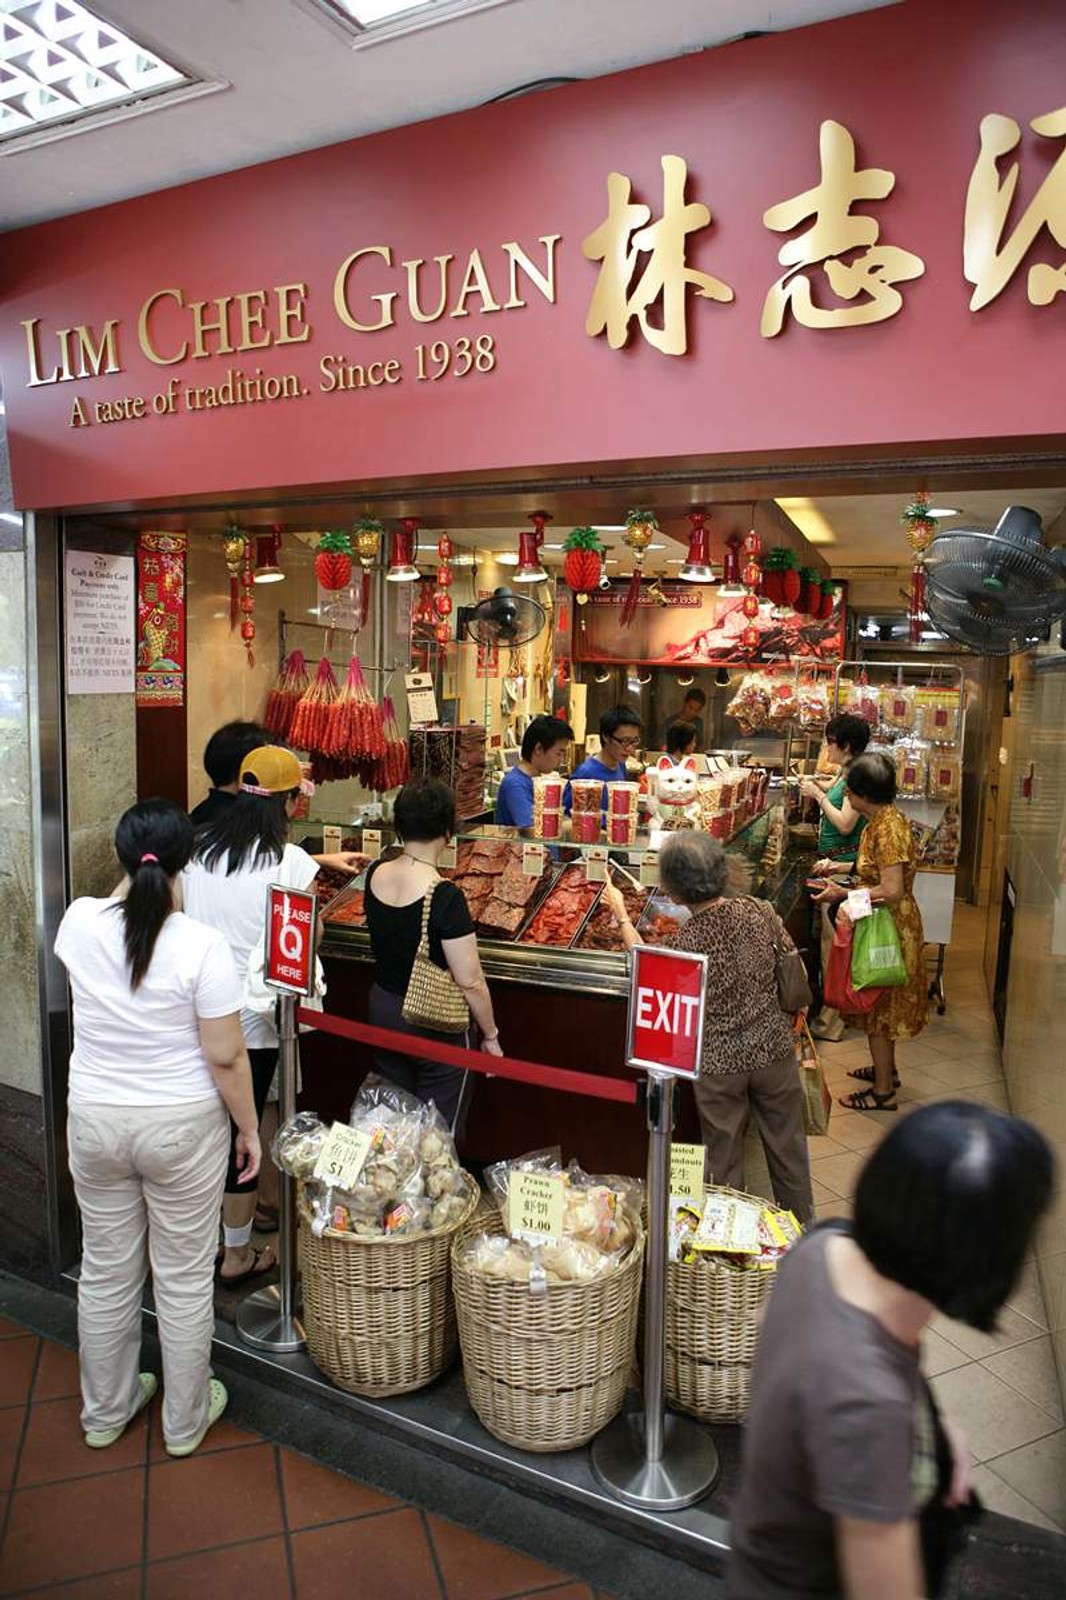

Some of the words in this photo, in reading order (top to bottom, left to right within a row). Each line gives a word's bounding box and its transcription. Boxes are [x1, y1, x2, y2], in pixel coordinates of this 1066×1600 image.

[20, 318, 121, 387] LIM
[138, 284, 311, 365] CHEE
[334, 234, 561, 332] GUAN
[69, 396, 89, 427] A
[95, 397, 146, 425] taste
[153, 378, 180, 415] of
[185, 369, 310, 411] tradition.
[320, 355, 402, 393] Since
[415, 335, 495, 382] 1938
[279, 924, 302, 962] Q
[277, 964, 302, 980] HERE
[636, 987, 699, 1037] EXIT
[330, 1162, 343, 1176] $1
[521, 1216, 551, 1232] $1.00
